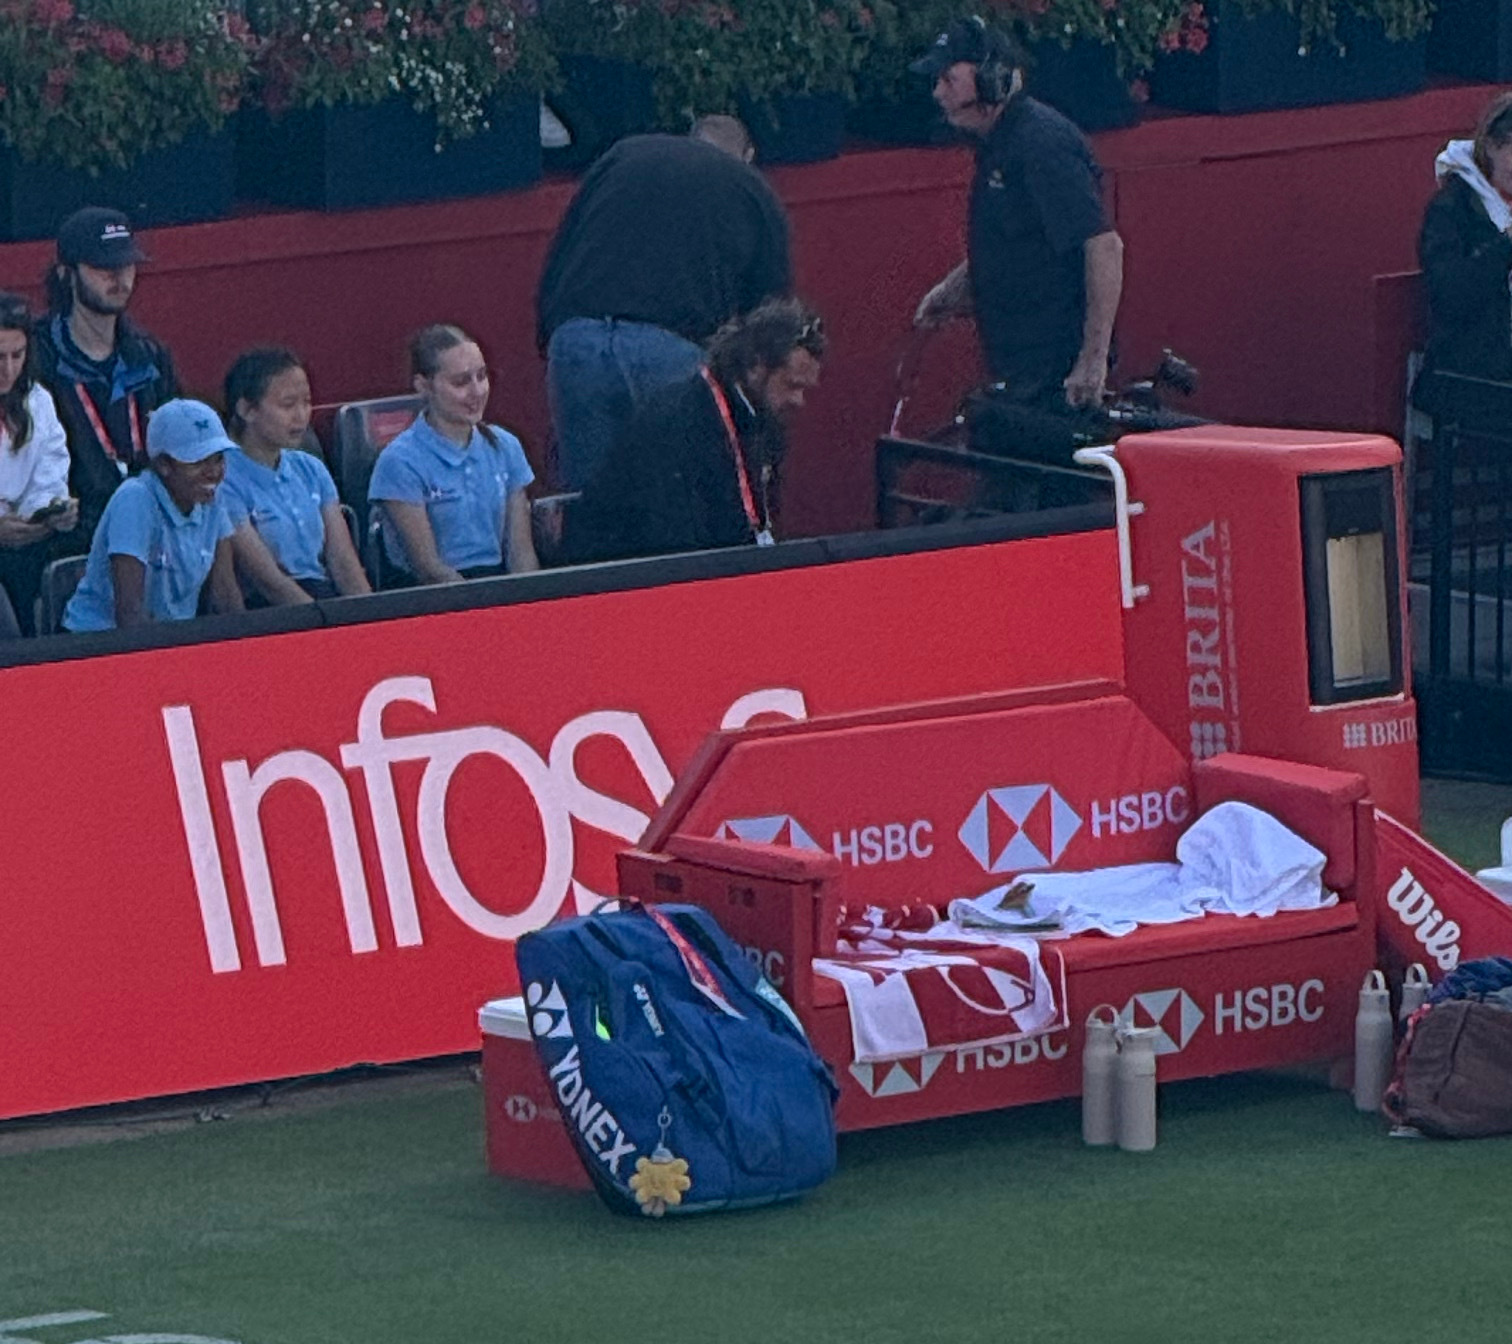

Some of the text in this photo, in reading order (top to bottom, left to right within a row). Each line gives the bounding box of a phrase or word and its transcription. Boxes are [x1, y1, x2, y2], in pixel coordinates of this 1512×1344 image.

[1181, 519, 1225, 710] BRITA
[1370, 716, 1417, 747] BRIT
[161, 675, 807, 973] Infos
[832, 819, 934, 868] HSBC
[1090, 785, 1189, 838] HSBC
[1387, 866, 1461, 971] Wils
[1215, 978, 1325, 1036] HSBC
[549, 1044, 637, 1175] YONEX
